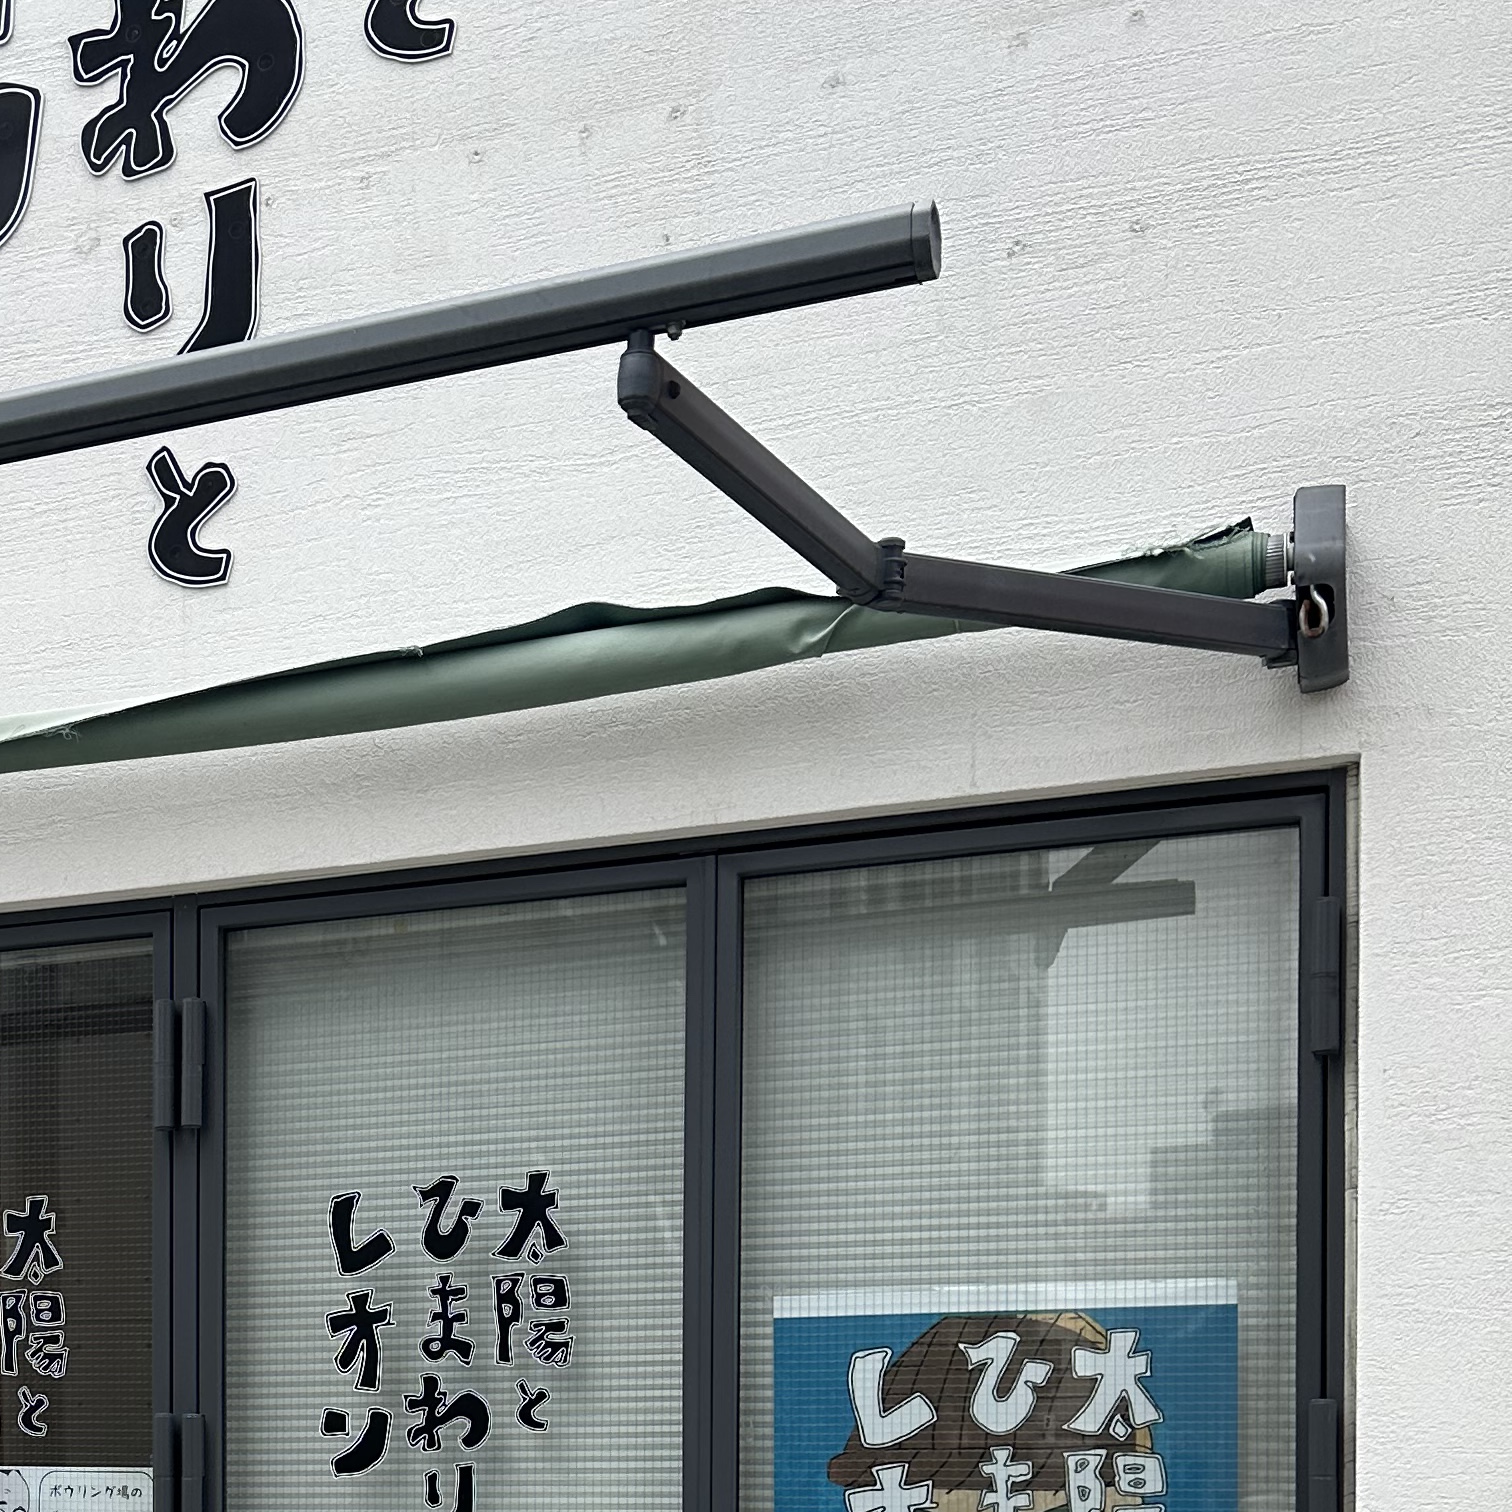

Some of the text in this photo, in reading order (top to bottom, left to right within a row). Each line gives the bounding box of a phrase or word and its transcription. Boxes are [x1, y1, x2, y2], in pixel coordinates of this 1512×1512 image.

[320, 1191, 396, 1479] レオン
[489, 1170, 575, 1433] 太陽と
[49, 1484, 143, 1501] ボウリング場の
